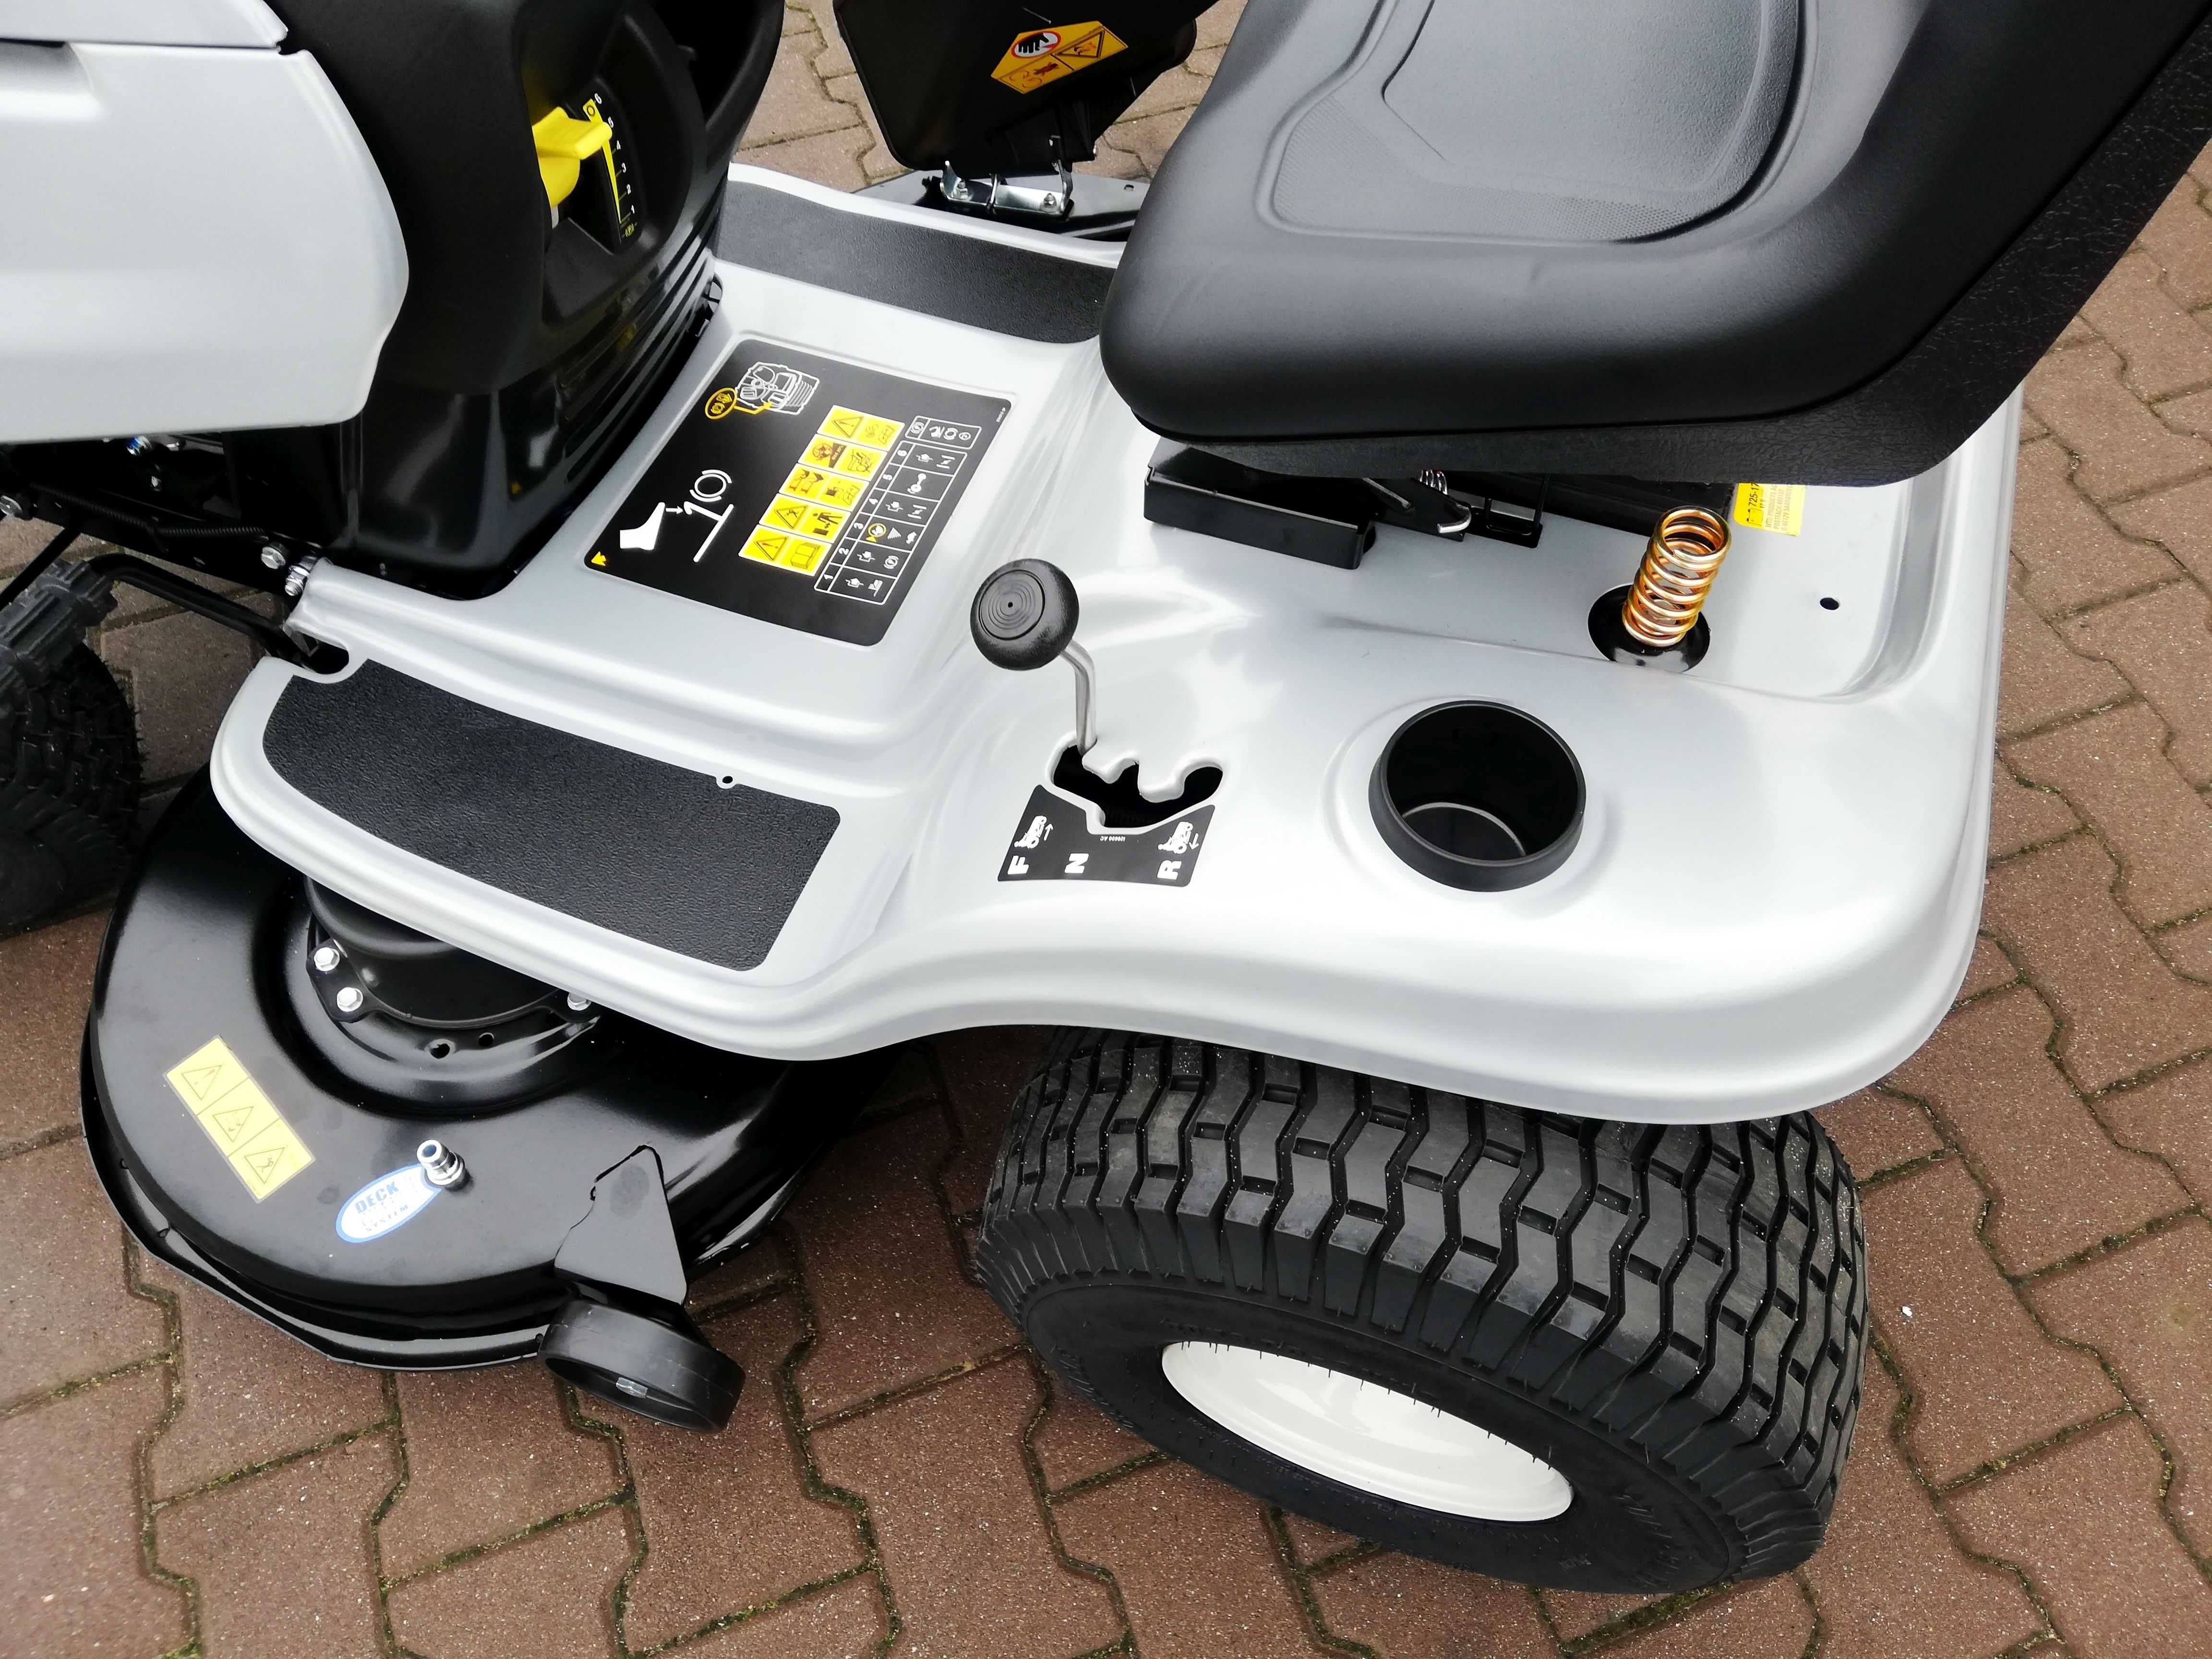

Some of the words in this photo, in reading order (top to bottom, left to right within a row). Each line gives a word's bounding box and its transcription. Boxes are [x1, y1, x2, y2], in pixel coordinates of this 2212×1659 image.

[616, 140, 621, 150] 4
[621, 162, 627, 173] 3
[626, 184, 631, 194] 2
[630, 204, 635, 214] 1
[897, 449, 908, 457] 6
[1007, 855, 1030, 875] F
[1064, 853, 1090, 874] N
[1156, 859, 1182, 880] R
[355, 1181, 399, 1214] DECK
